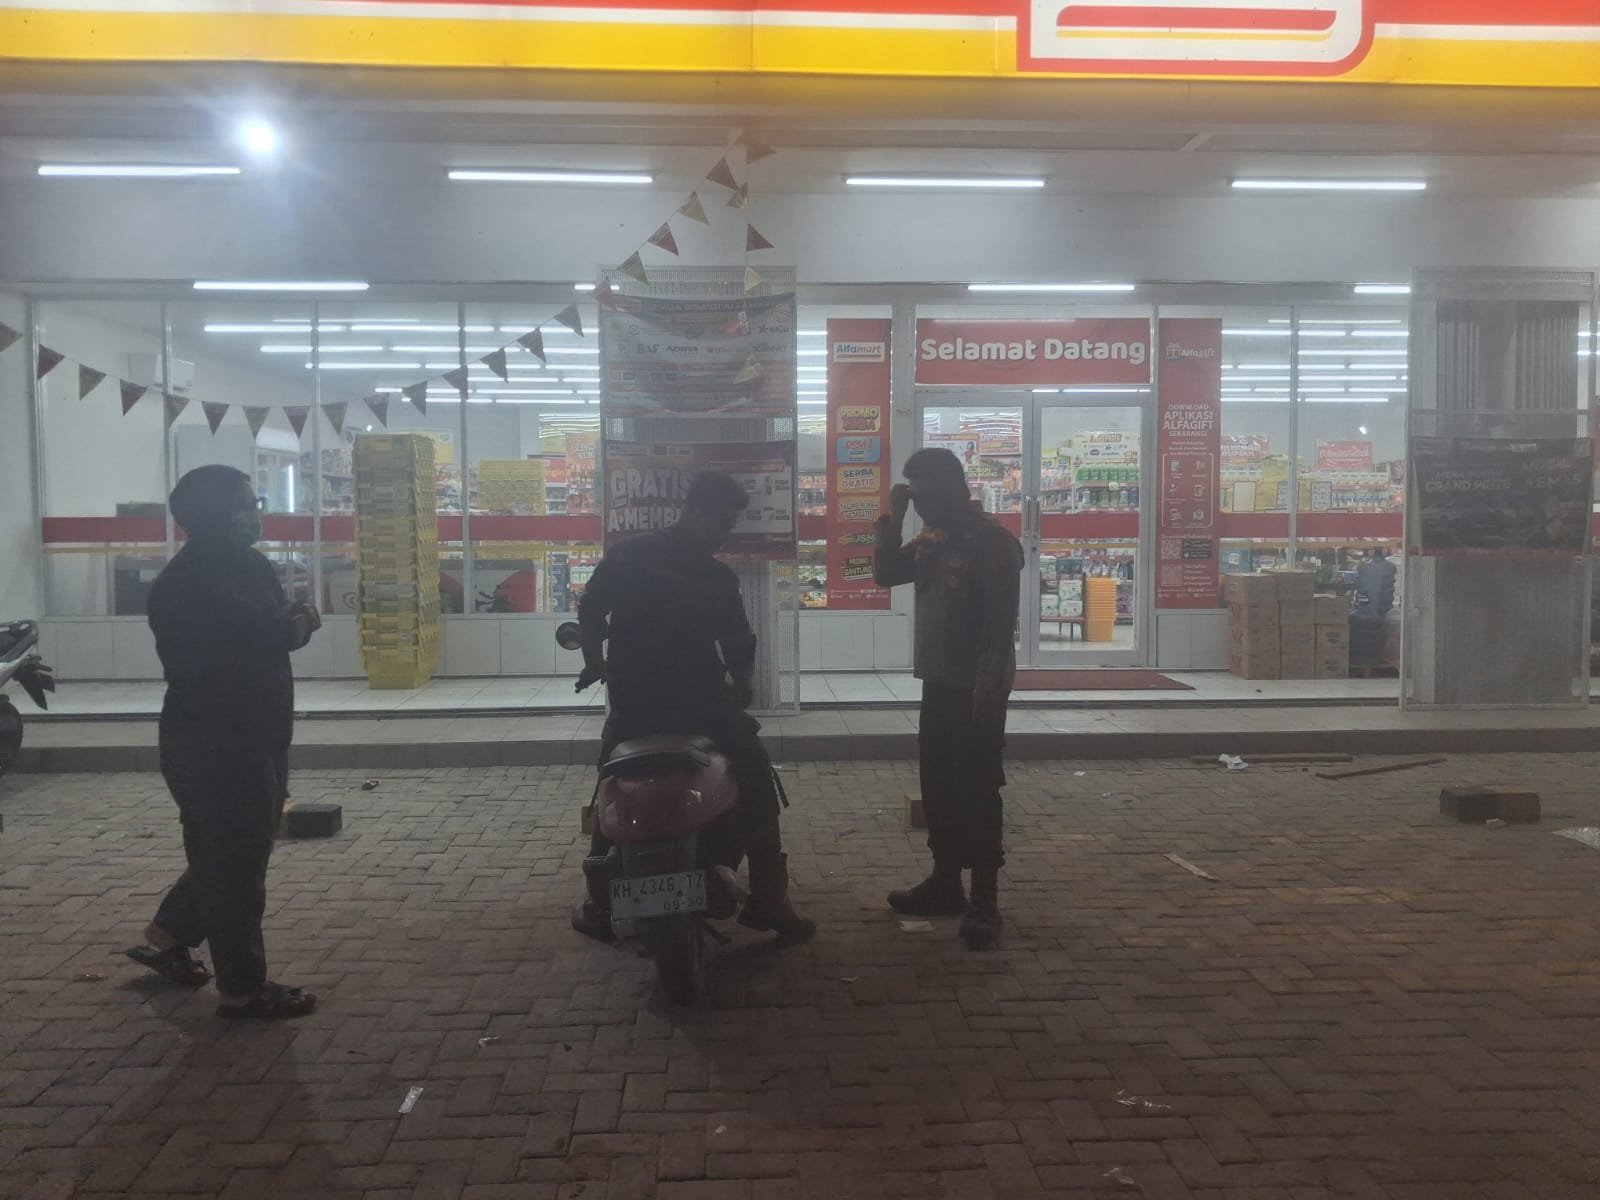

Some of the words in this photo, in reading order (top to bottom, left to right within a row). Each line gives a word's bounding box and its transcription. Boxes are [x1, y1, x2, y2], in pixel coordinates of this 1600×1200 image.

[836, 343, 882, 354] Alfamart
[920, 338, 1037, 361] Selamat
[1043, 338, 1146, 365] Datang
[1181, 347, 1215, 359] Alfagift
[1168, 403, 1209, 411] DOWNLOAD
[1163, 410, 1213, 420] APLIKASI
[1162, 420, 1215, 430] ALFAGIFT
[843, 467, 874, 478] SERBA
[609, 467, 692, 500] GRATIS
[841, 478, 875, 488] GRATIS
[613, 879, 632, 900] KH
